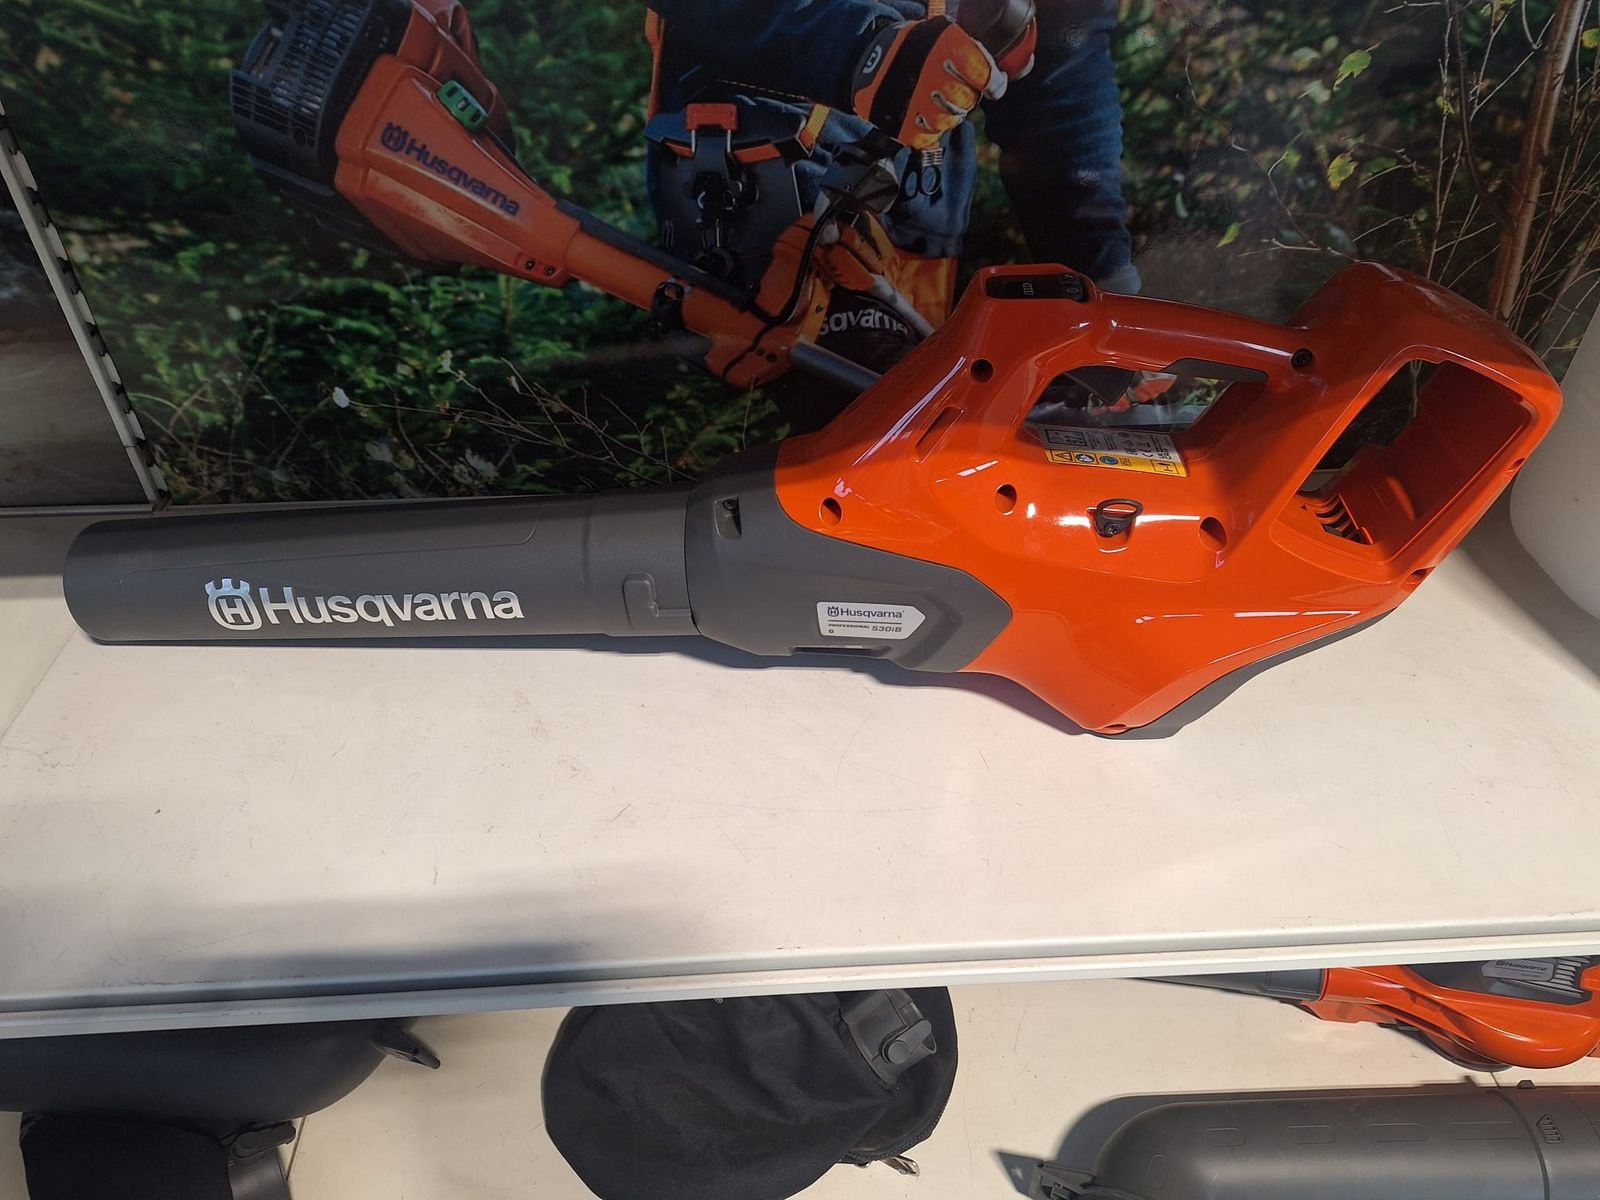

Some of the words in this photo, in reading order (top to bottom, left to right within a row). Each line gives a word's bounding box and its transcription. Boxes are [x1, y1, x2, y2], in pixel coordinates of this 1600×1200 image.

[405, 138, 520, 217] Husqvarna
[258, 586, 525, 627] Husqvarna
[840, 608, 903, 618] Husqvarna
[872, 625, 902, 633] 530iB
[1504, 961, 1547, 971] Husqvarna
